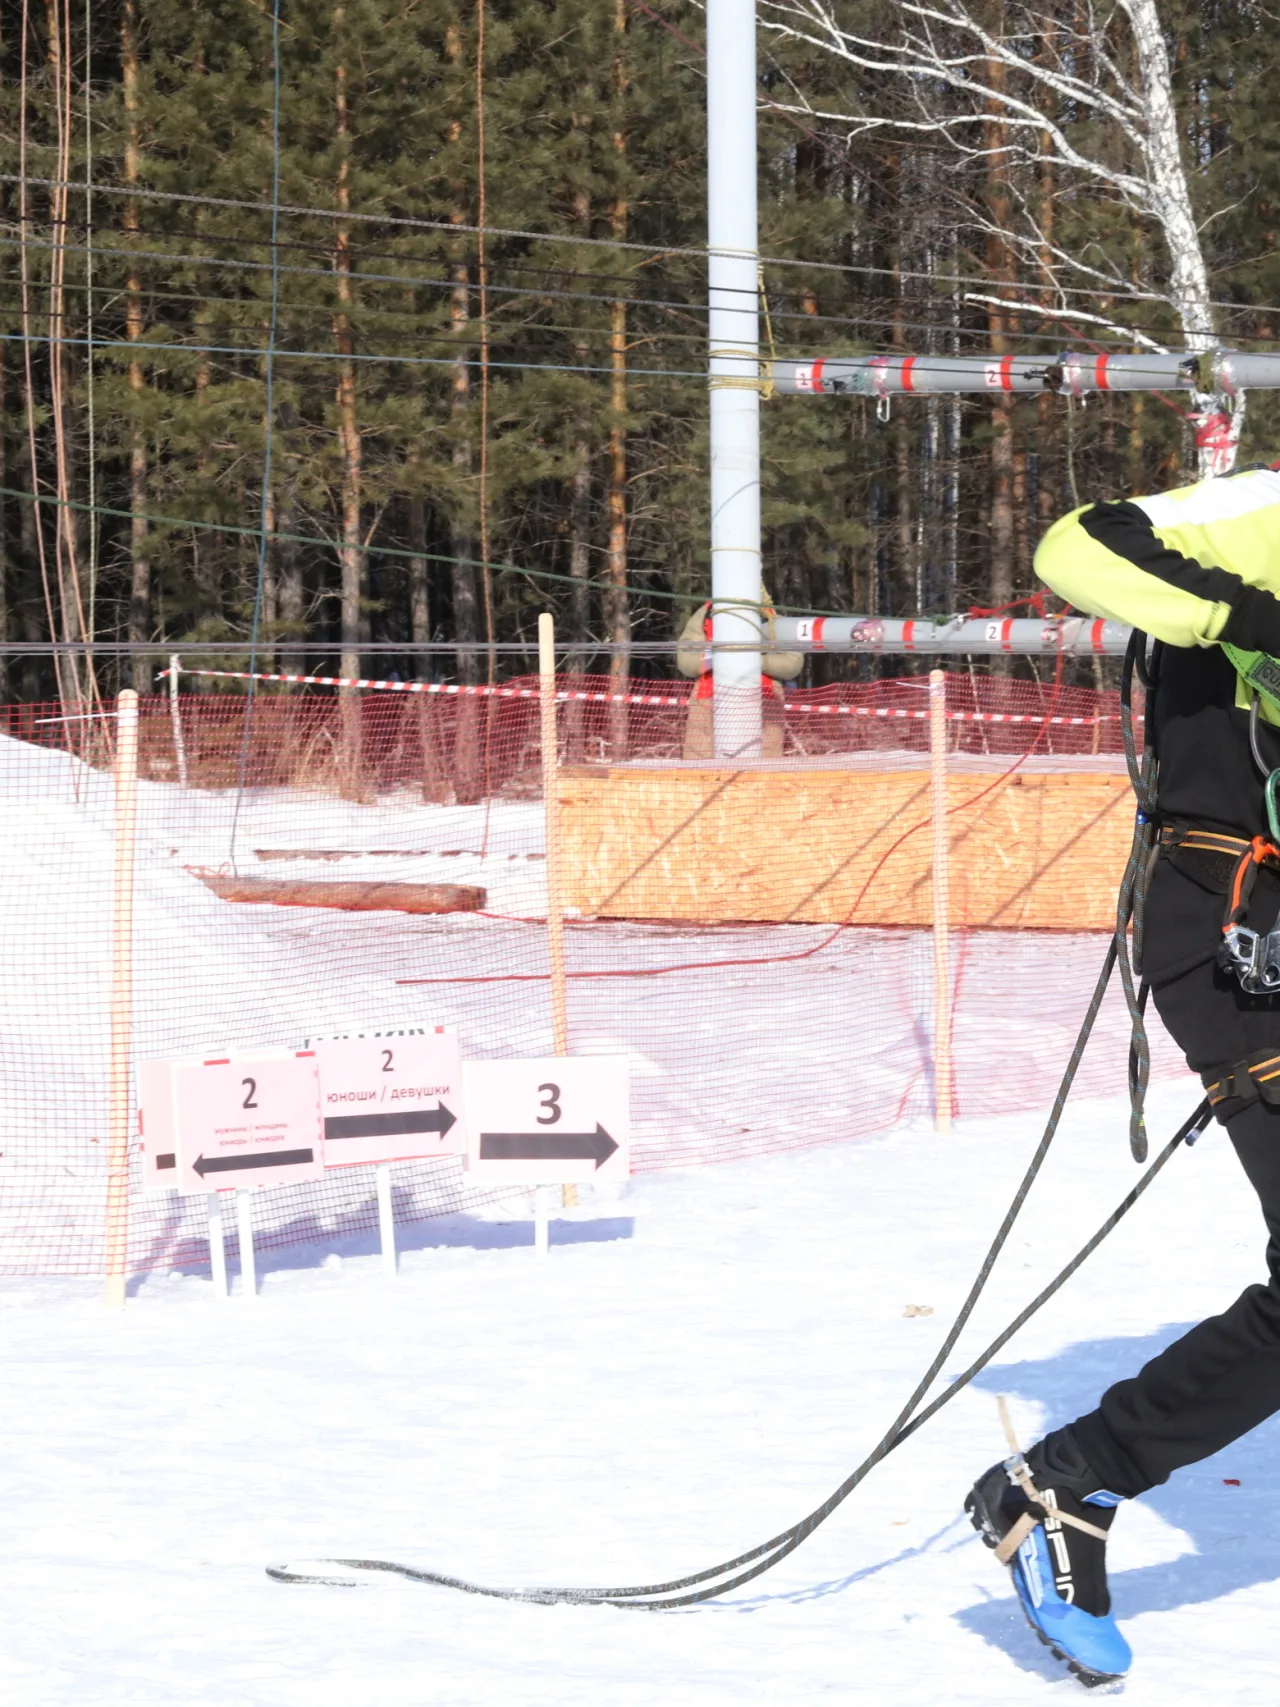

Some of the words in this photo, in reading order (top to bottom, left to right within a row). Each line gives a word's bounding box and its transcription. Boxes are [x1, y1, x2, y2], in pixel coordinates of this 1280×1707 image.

[800, 372, 809, 386] 1
[988, 370, 997, 383] 2
[800, 624, 808, 637] 1
[988, 626, 997, 639] 2
[381, 1049, 395, 1072] 2
[241, 1077, 259, 1109] 2
[326, 1090, 377, 1103] юноши
[390, 1085, 450, 1101] девушки
[536, 1083, 562, 1125] 3
